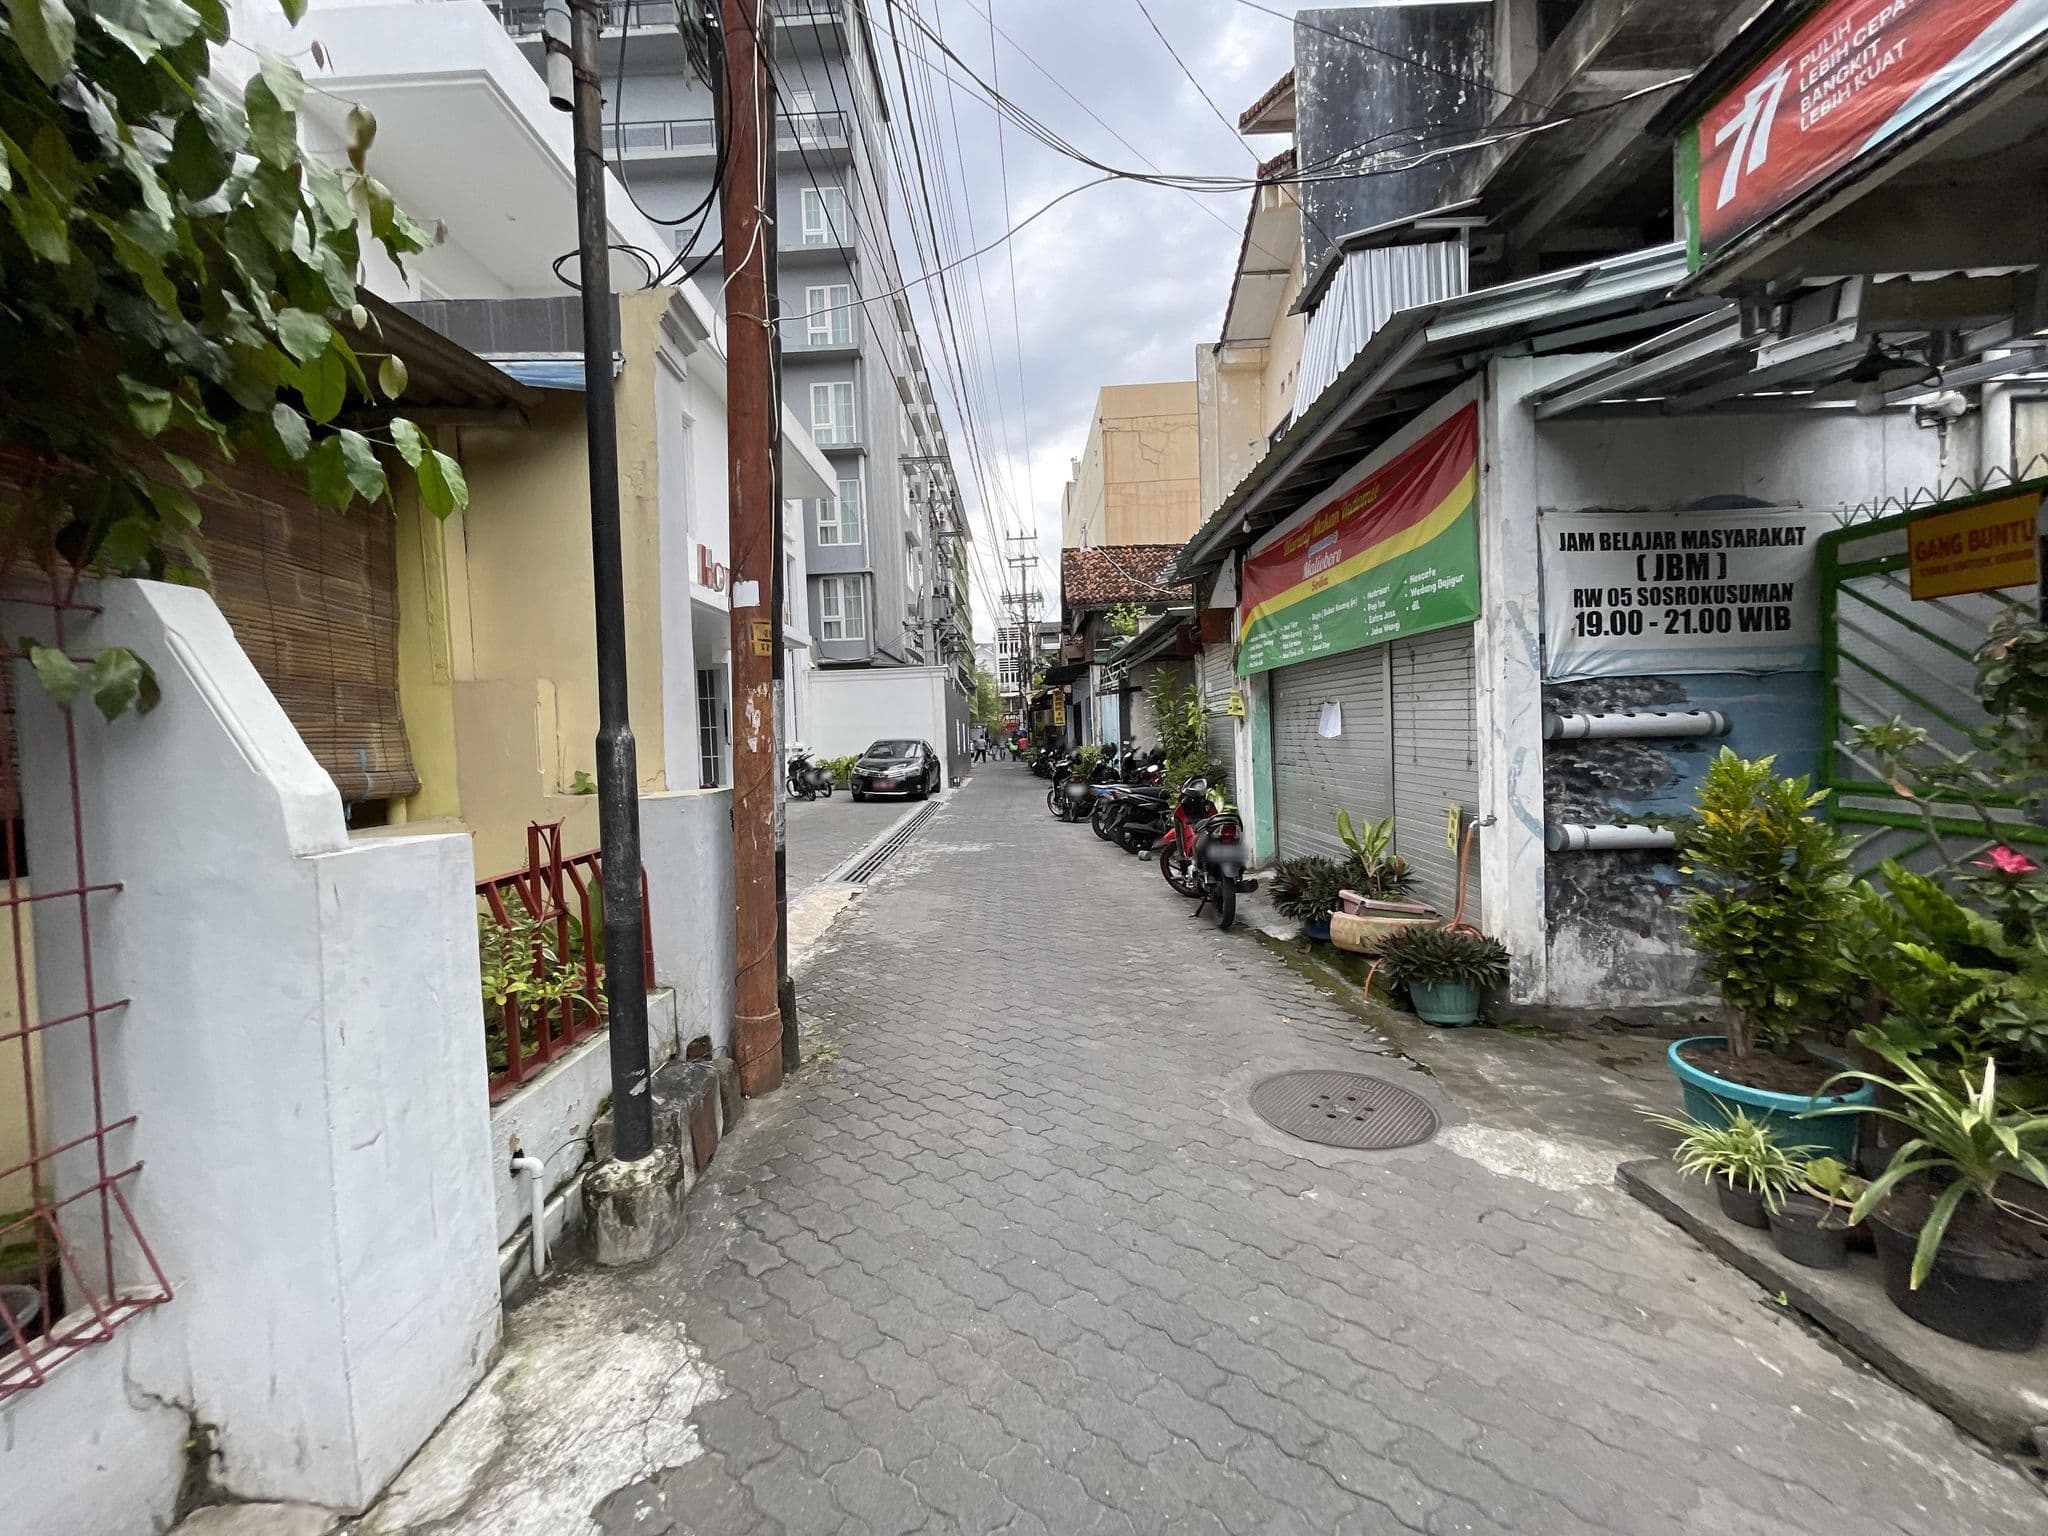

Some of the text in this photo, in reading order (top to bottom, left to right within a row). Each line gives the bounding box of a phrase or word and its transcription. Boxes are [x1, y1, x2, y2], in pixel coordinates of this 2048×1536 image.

[1800, 17, 1851, 73] PULIH
[1800, 0, 1914, 93] LEBIH CEPA
[1801, 37, 1881, 114] BANGKIT
[1801, 37, 1907, 131] LEBIH KUAT
[1559, 526, 1806, 551] JAM BELAJAR MASYARAKAT
[1916, 533, 1963, 562] GANG
[1968, 518, 2035, 552] BUNTU
[1409, 567, 1436, 584] Nescafe
[1653, 553, 1709, 581] JBM
[1410, 574, 1464, 597] Wedang Bajigur
[1573, 582, 1794, 608] RW 05 SOSROKUSUMAN
[1575, 610, 1643, 637] 19.00
[1664, 607, 1731, 635] 21.00
[1738, 606, 1791, 632] WIB
